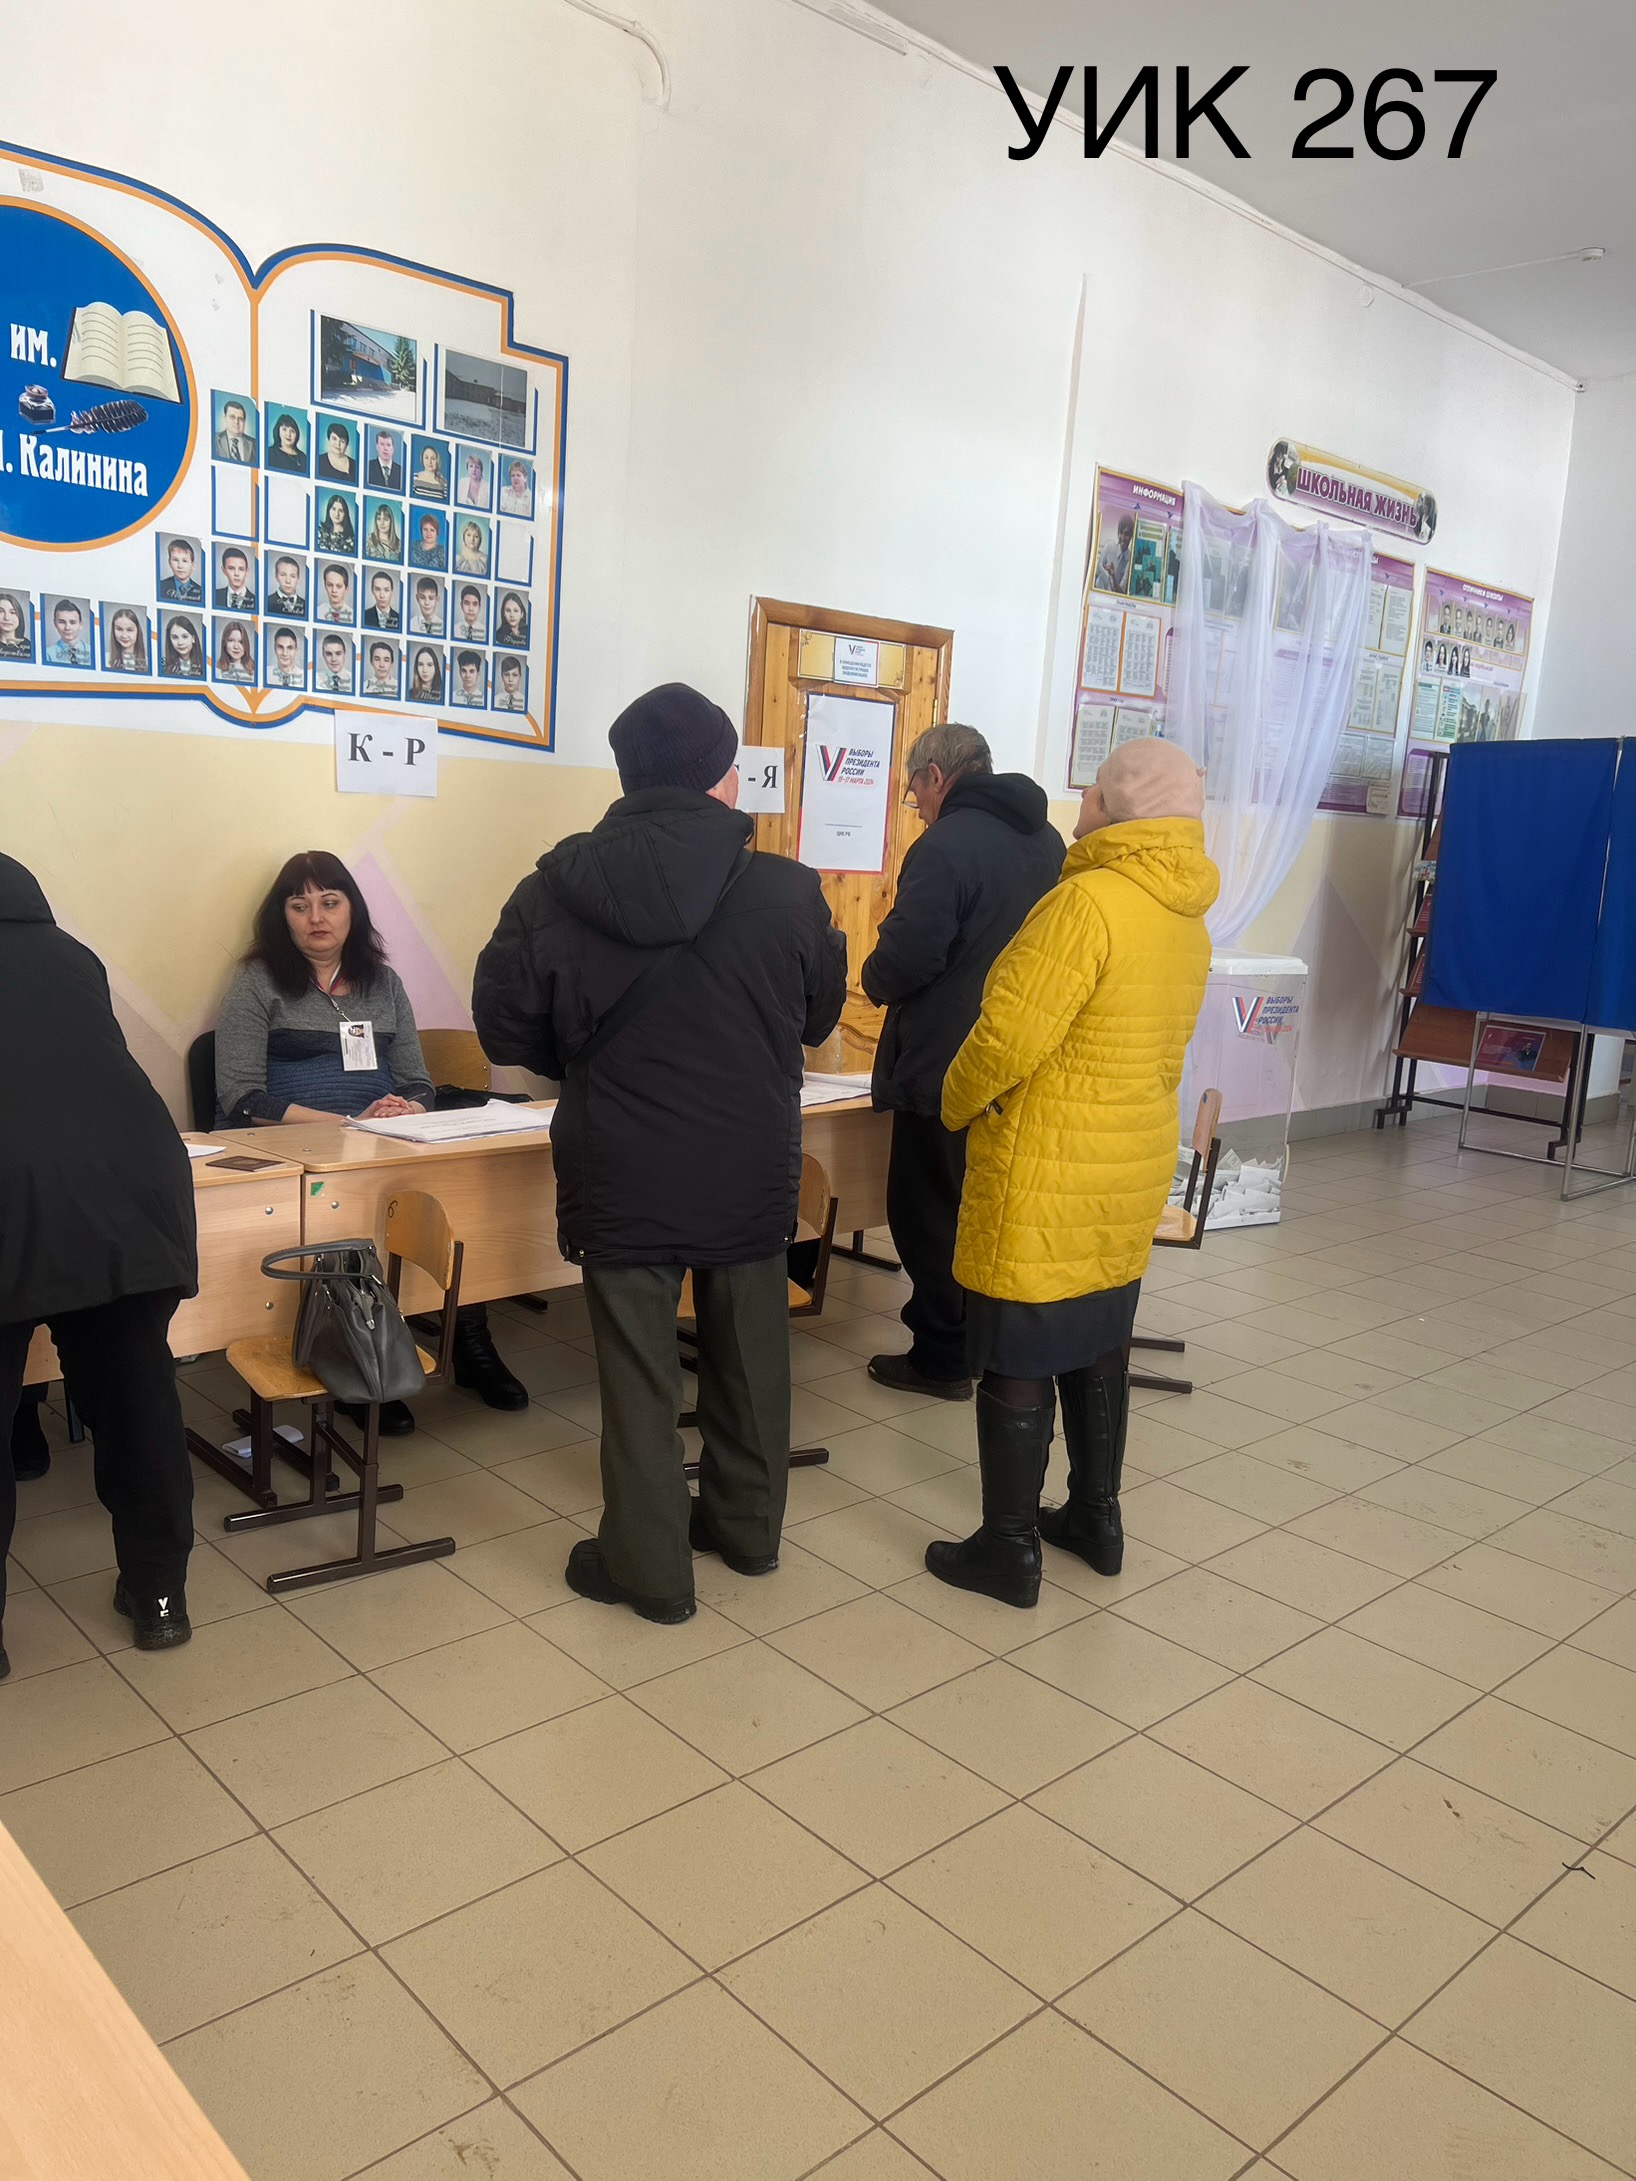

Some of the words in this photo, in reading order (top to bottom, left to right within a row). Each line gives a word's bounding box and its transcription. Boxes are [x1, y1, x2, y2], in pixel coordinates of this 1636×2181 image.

[10, 323, 57, 369] им.
[19, 433, 149, 497] Калинина
[1132, 484, 1176, 506] ИНФОРМАЦИЯ
[1296, 467, 1373, 513] ШКОЛЬНАЯ
[1373, 494, 1418, 527] ЖИЗНЬ
[347, 732, 374, 762] К
[404, 737, 426, 766] Р
[848, 748, 875, 758] ВЫБОРЫ
[840, 767, 865, 776] РОССИИ
[844, 757, 880, 768] ПРЕЗИДЕНТА
[761, 765, 778, 788] Я
[1266, 995, 1294, 1005] ВЫБОРЫ
[1262, 1005, 1300, 1015] ПРЕЗИДЕНТА
[1257, 1016, 1283, 1025] РОССИИ
[387, 1200, 399, 1219] 6
